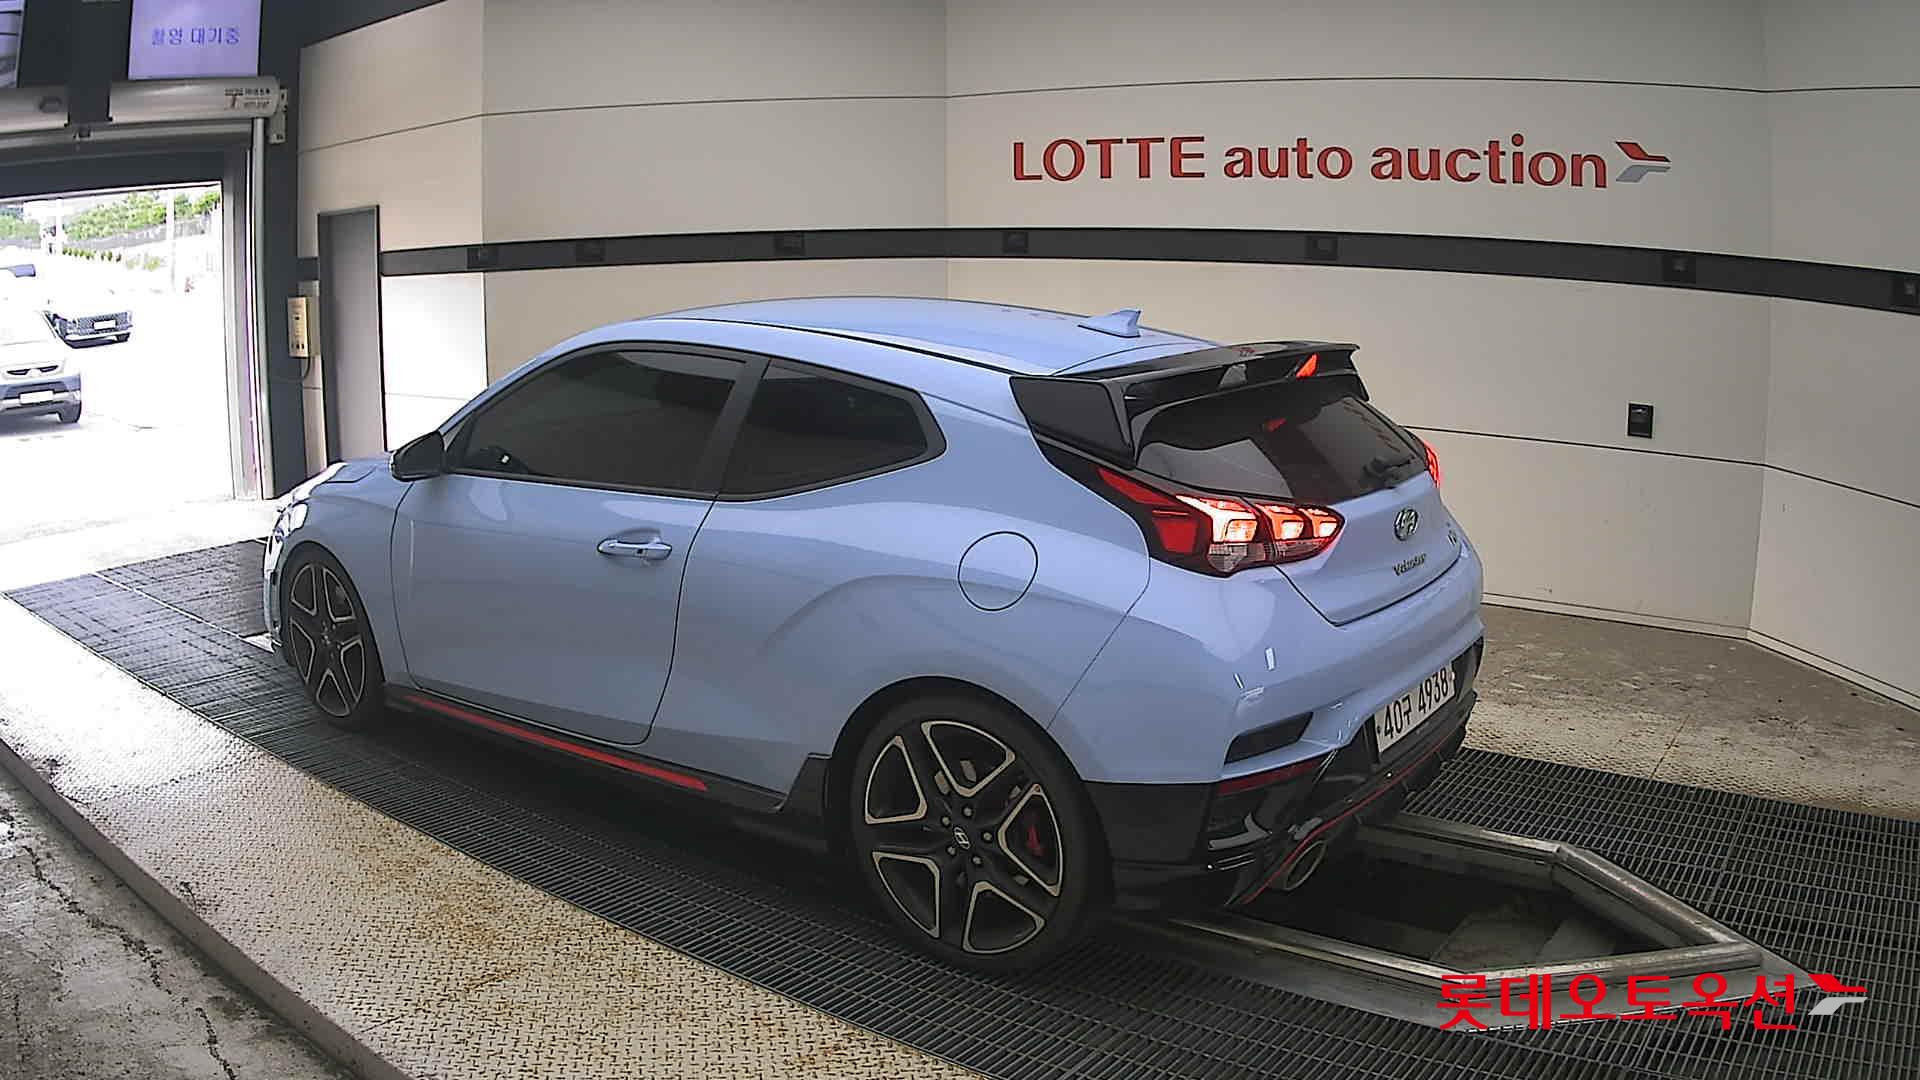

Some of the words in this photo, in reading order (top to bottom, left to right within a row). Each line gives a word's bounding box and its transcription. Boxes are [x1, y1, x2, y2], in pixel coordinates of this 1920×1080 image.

[191, 27, 240, 45] 대기중
[1014, 136, 1205, 181] LOTTE
[1223, 138, 1354, 180] auto
[1370, 133, 1608, 188] auction
[1384, 694, 1412, 739] 40구
[1418, 667, 1449, 714] 4938
